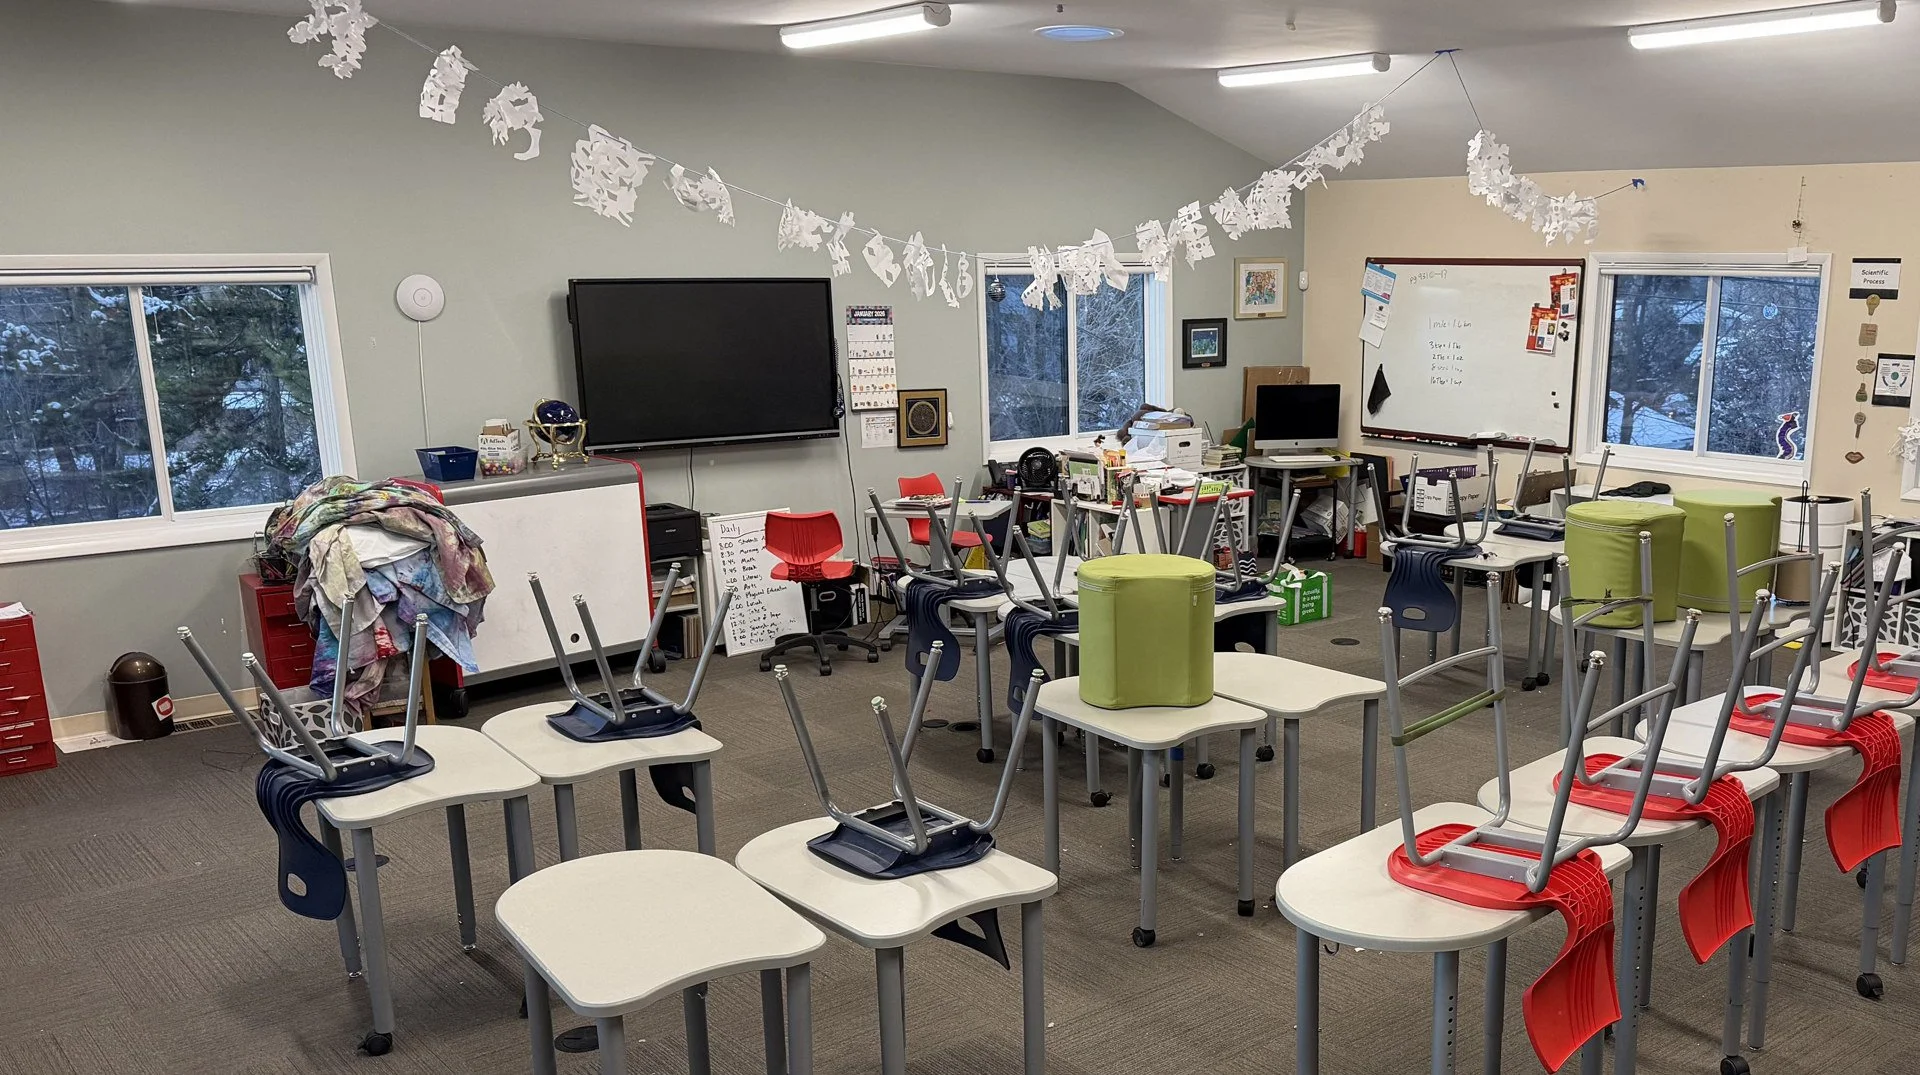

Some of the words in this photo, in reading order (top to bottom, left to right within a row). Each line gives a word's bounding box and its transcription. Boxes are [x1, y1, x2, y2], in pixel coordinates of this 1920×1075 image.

[720, 523, 741, 535] Daily
[741, 564, 758, 572] Break
[766, 585, 788, 595] Education
